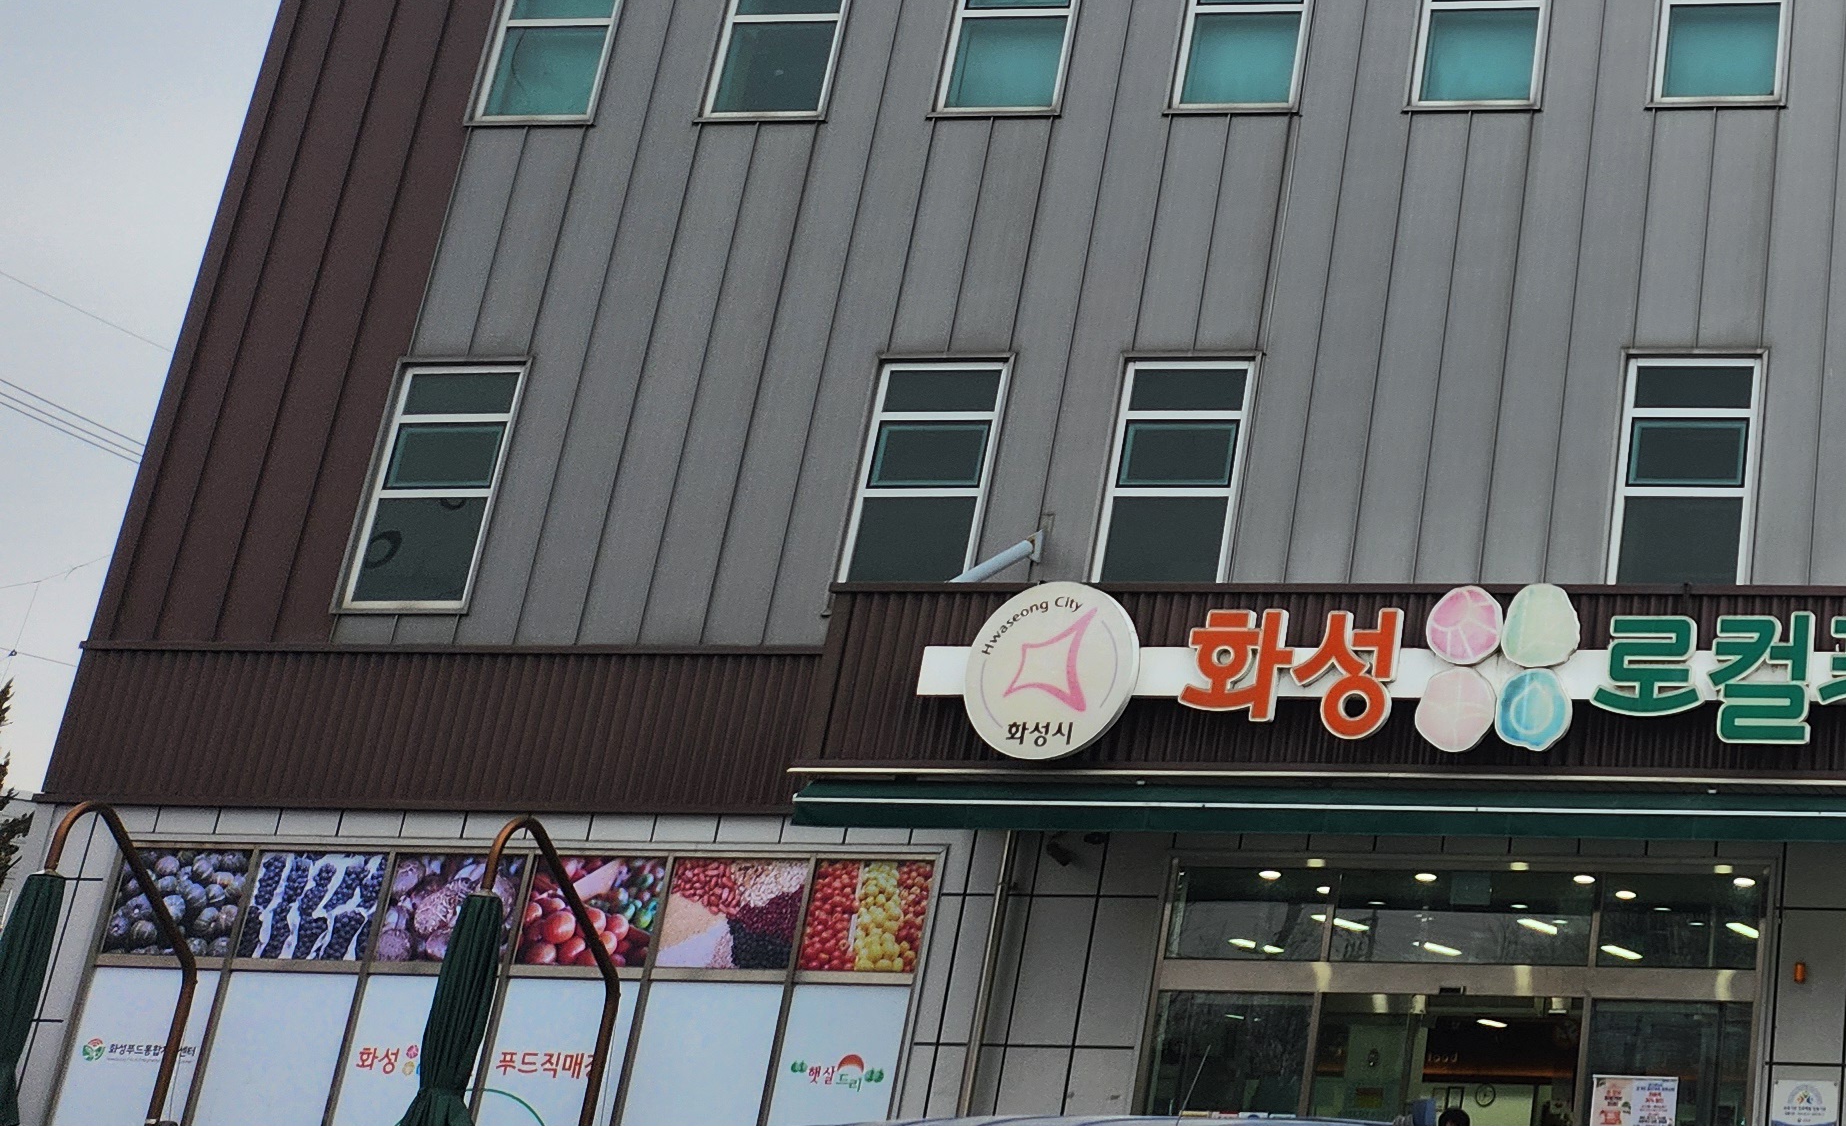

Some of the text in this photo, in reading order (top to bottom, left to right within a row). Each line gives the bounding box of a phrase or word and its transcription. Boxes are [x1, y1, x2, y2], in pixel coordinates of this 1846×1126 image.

[981, 595, 1084, 656] Hwaseong City
[1178, 607, 1404, 741] 화성
[1005, 721, 1074, 748] 화성시
[107, 1043, 197, 1058] 화성푸드통합센터
[356, 1047, 400, 1074] 화성
